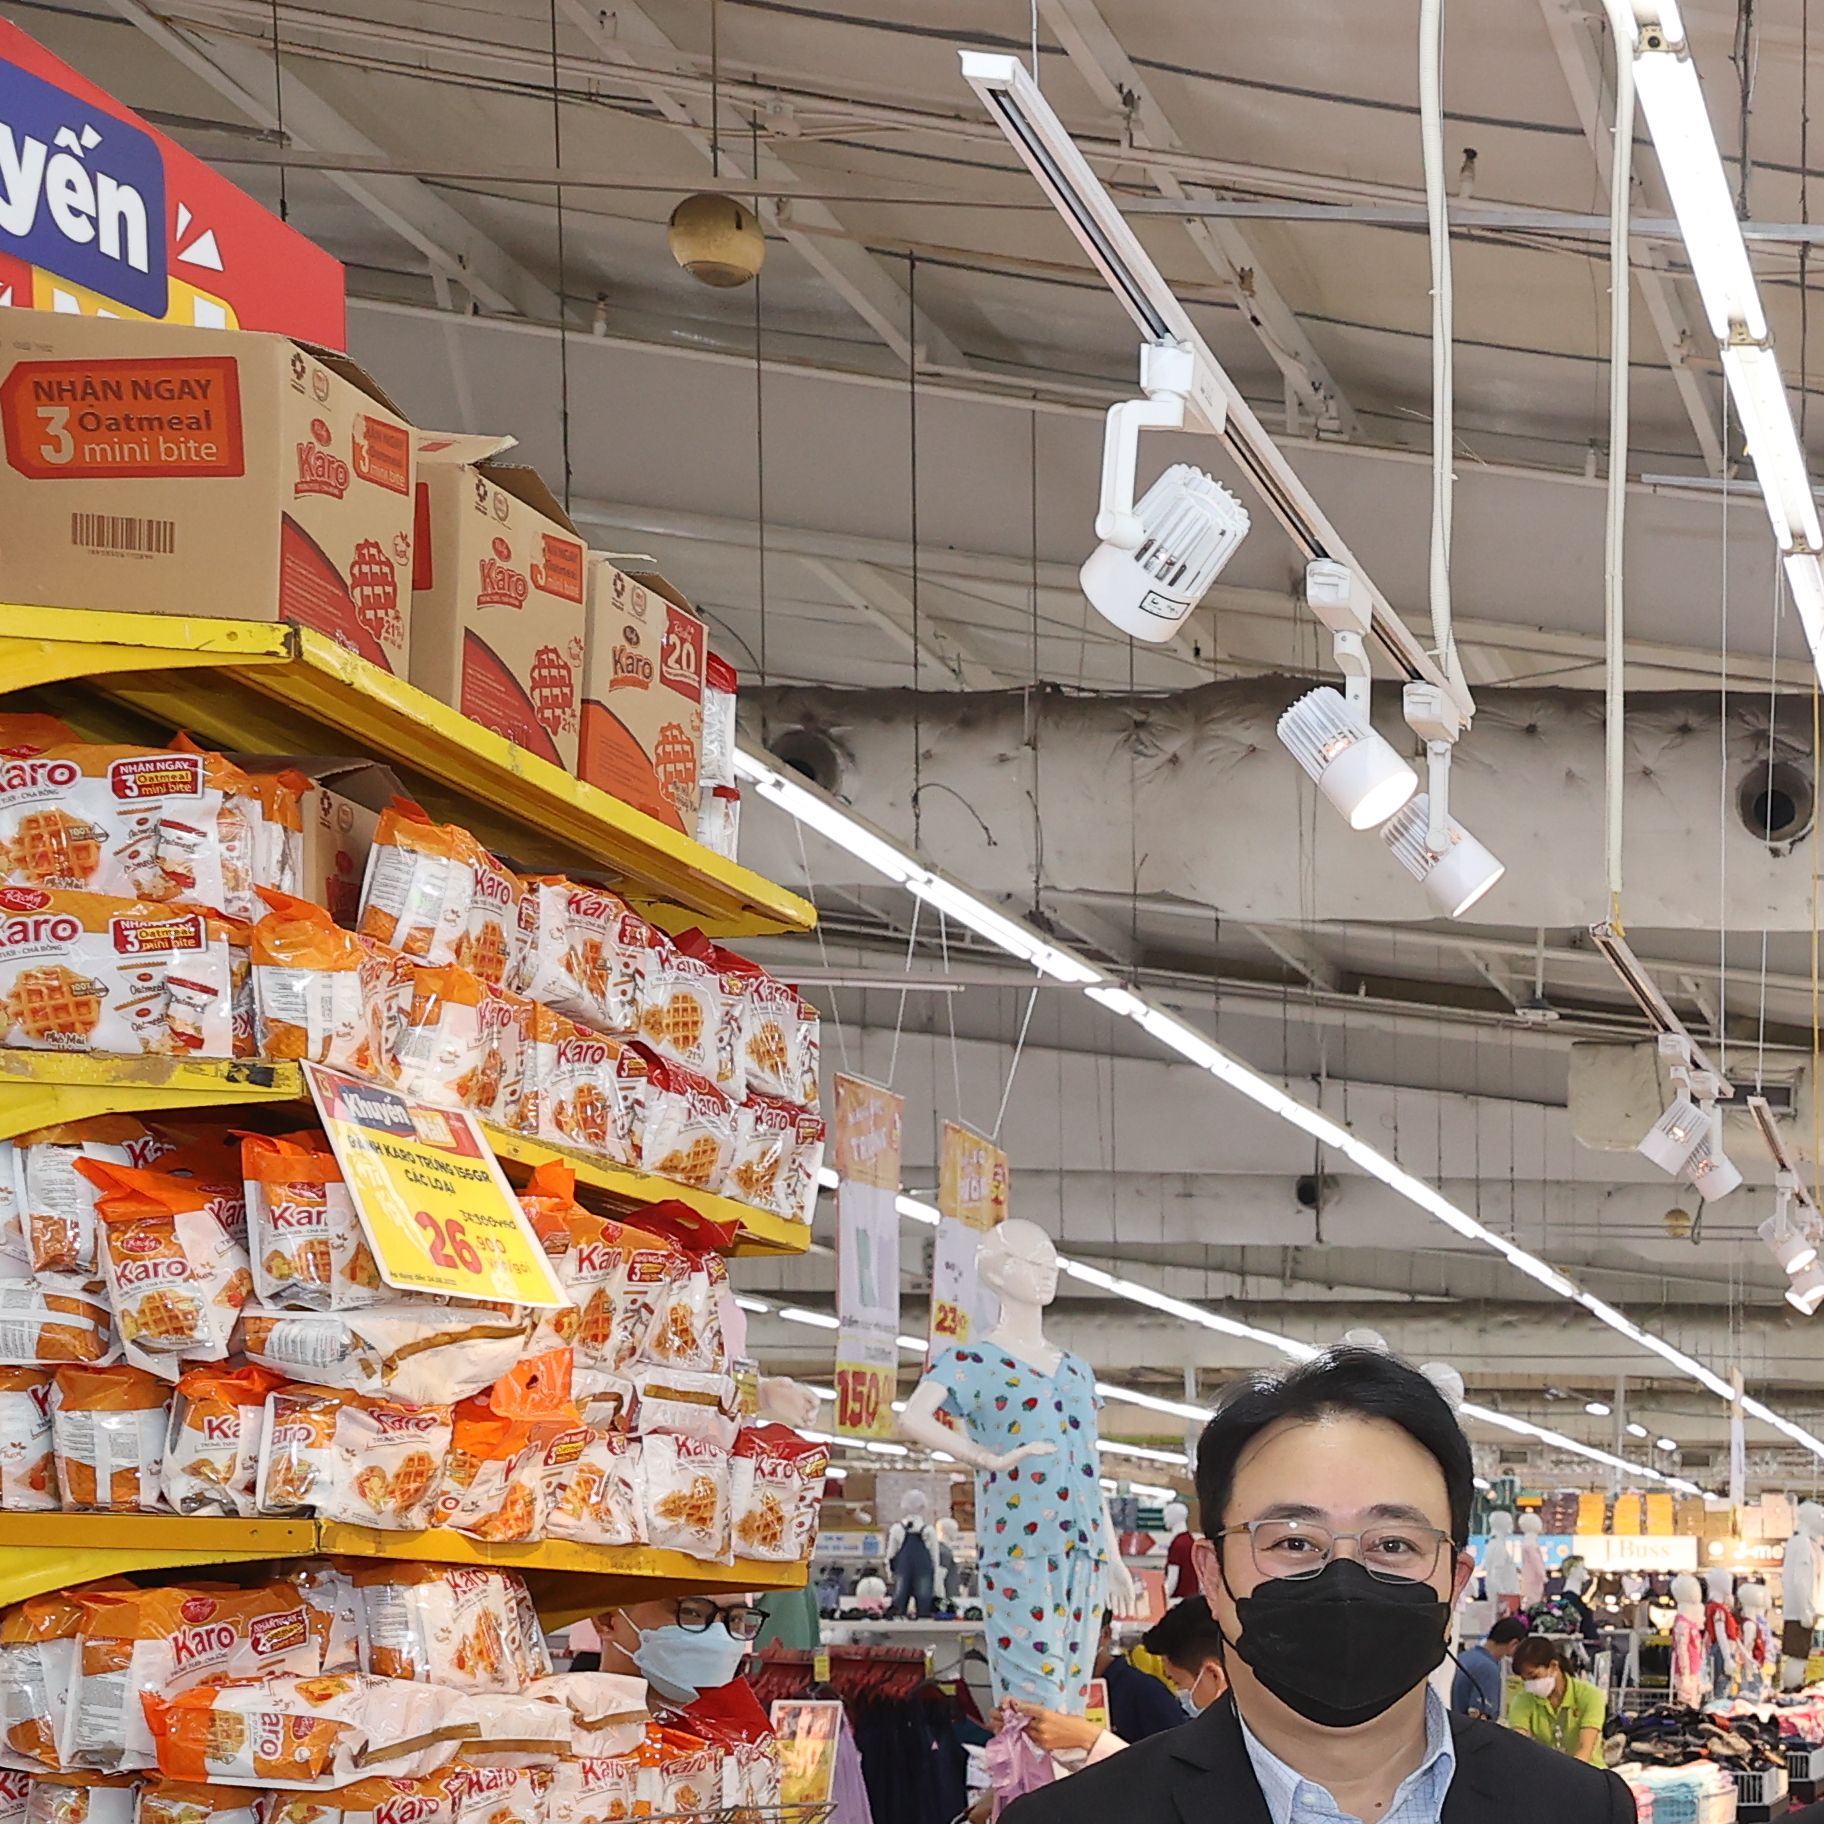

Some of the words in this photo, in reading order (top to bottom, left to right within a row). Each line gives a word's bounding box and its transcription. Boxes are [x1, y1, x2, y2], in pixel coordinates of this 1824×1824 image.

[130, 378, 212, 401] NGAY
[36, 406, 75, 464] 3
[78, 409, 213, 432] Oatmeal
[83, 437, 150, 462] mini
[159, 437, 218, 462] bite
[297, 442, 350, 491] Karo
[124, 775, 139, 797] 3
[138, 772, 192, 782] Oatmeal
[141, 784, 170, 794] mini
[173, 782, 192, 792] bite
[415, 1211, 483, 1275] 26
